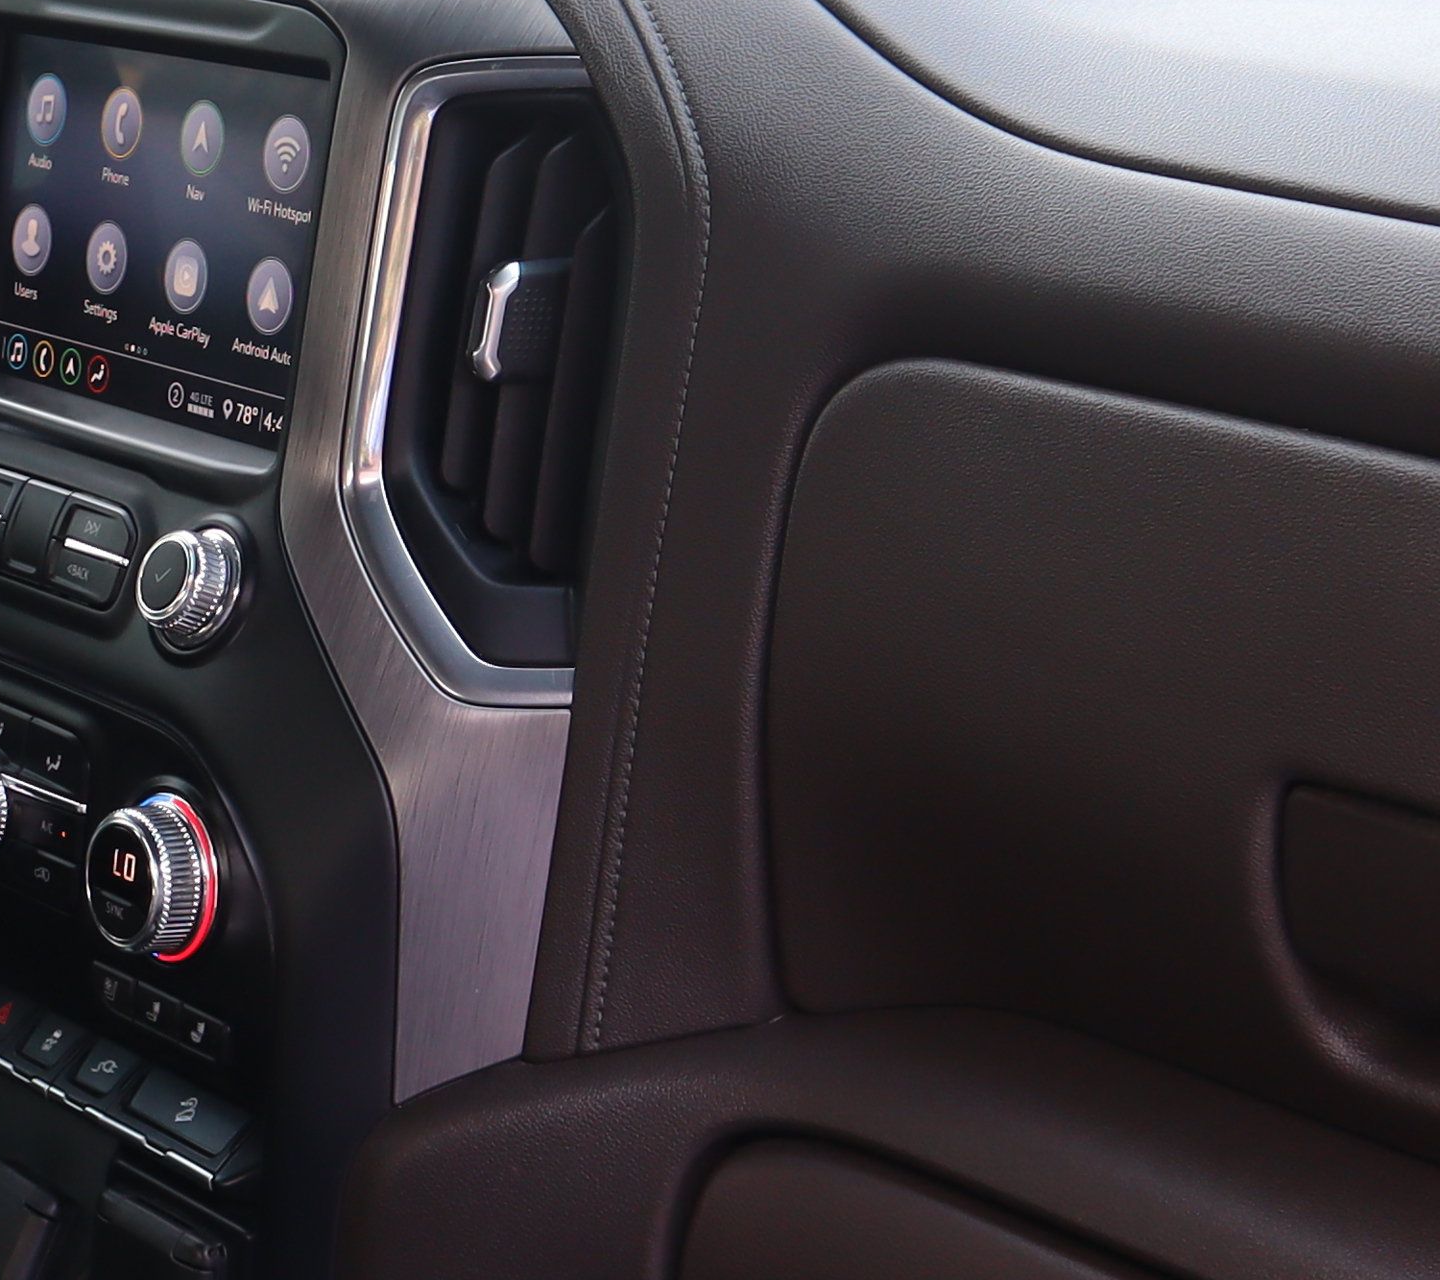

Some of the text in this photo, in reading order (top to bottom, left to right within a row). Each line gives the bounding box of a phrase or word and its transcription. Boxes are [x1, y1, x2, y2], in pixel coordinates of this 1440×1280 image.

[27, 152, 53, 170] Audio
[101, 166, 130, 187] Phone
[185, 183, 205, 202] Nav
[247, 196, 273, 216] Wi-Fi
[13, 281, 39, 302] Users
[82, 298, 119, 324] Settings
[148, 316, 212, 349] Apple CarPlay
[231, 337, 271, 361] Android
[112, 848, 137, 882] LO
